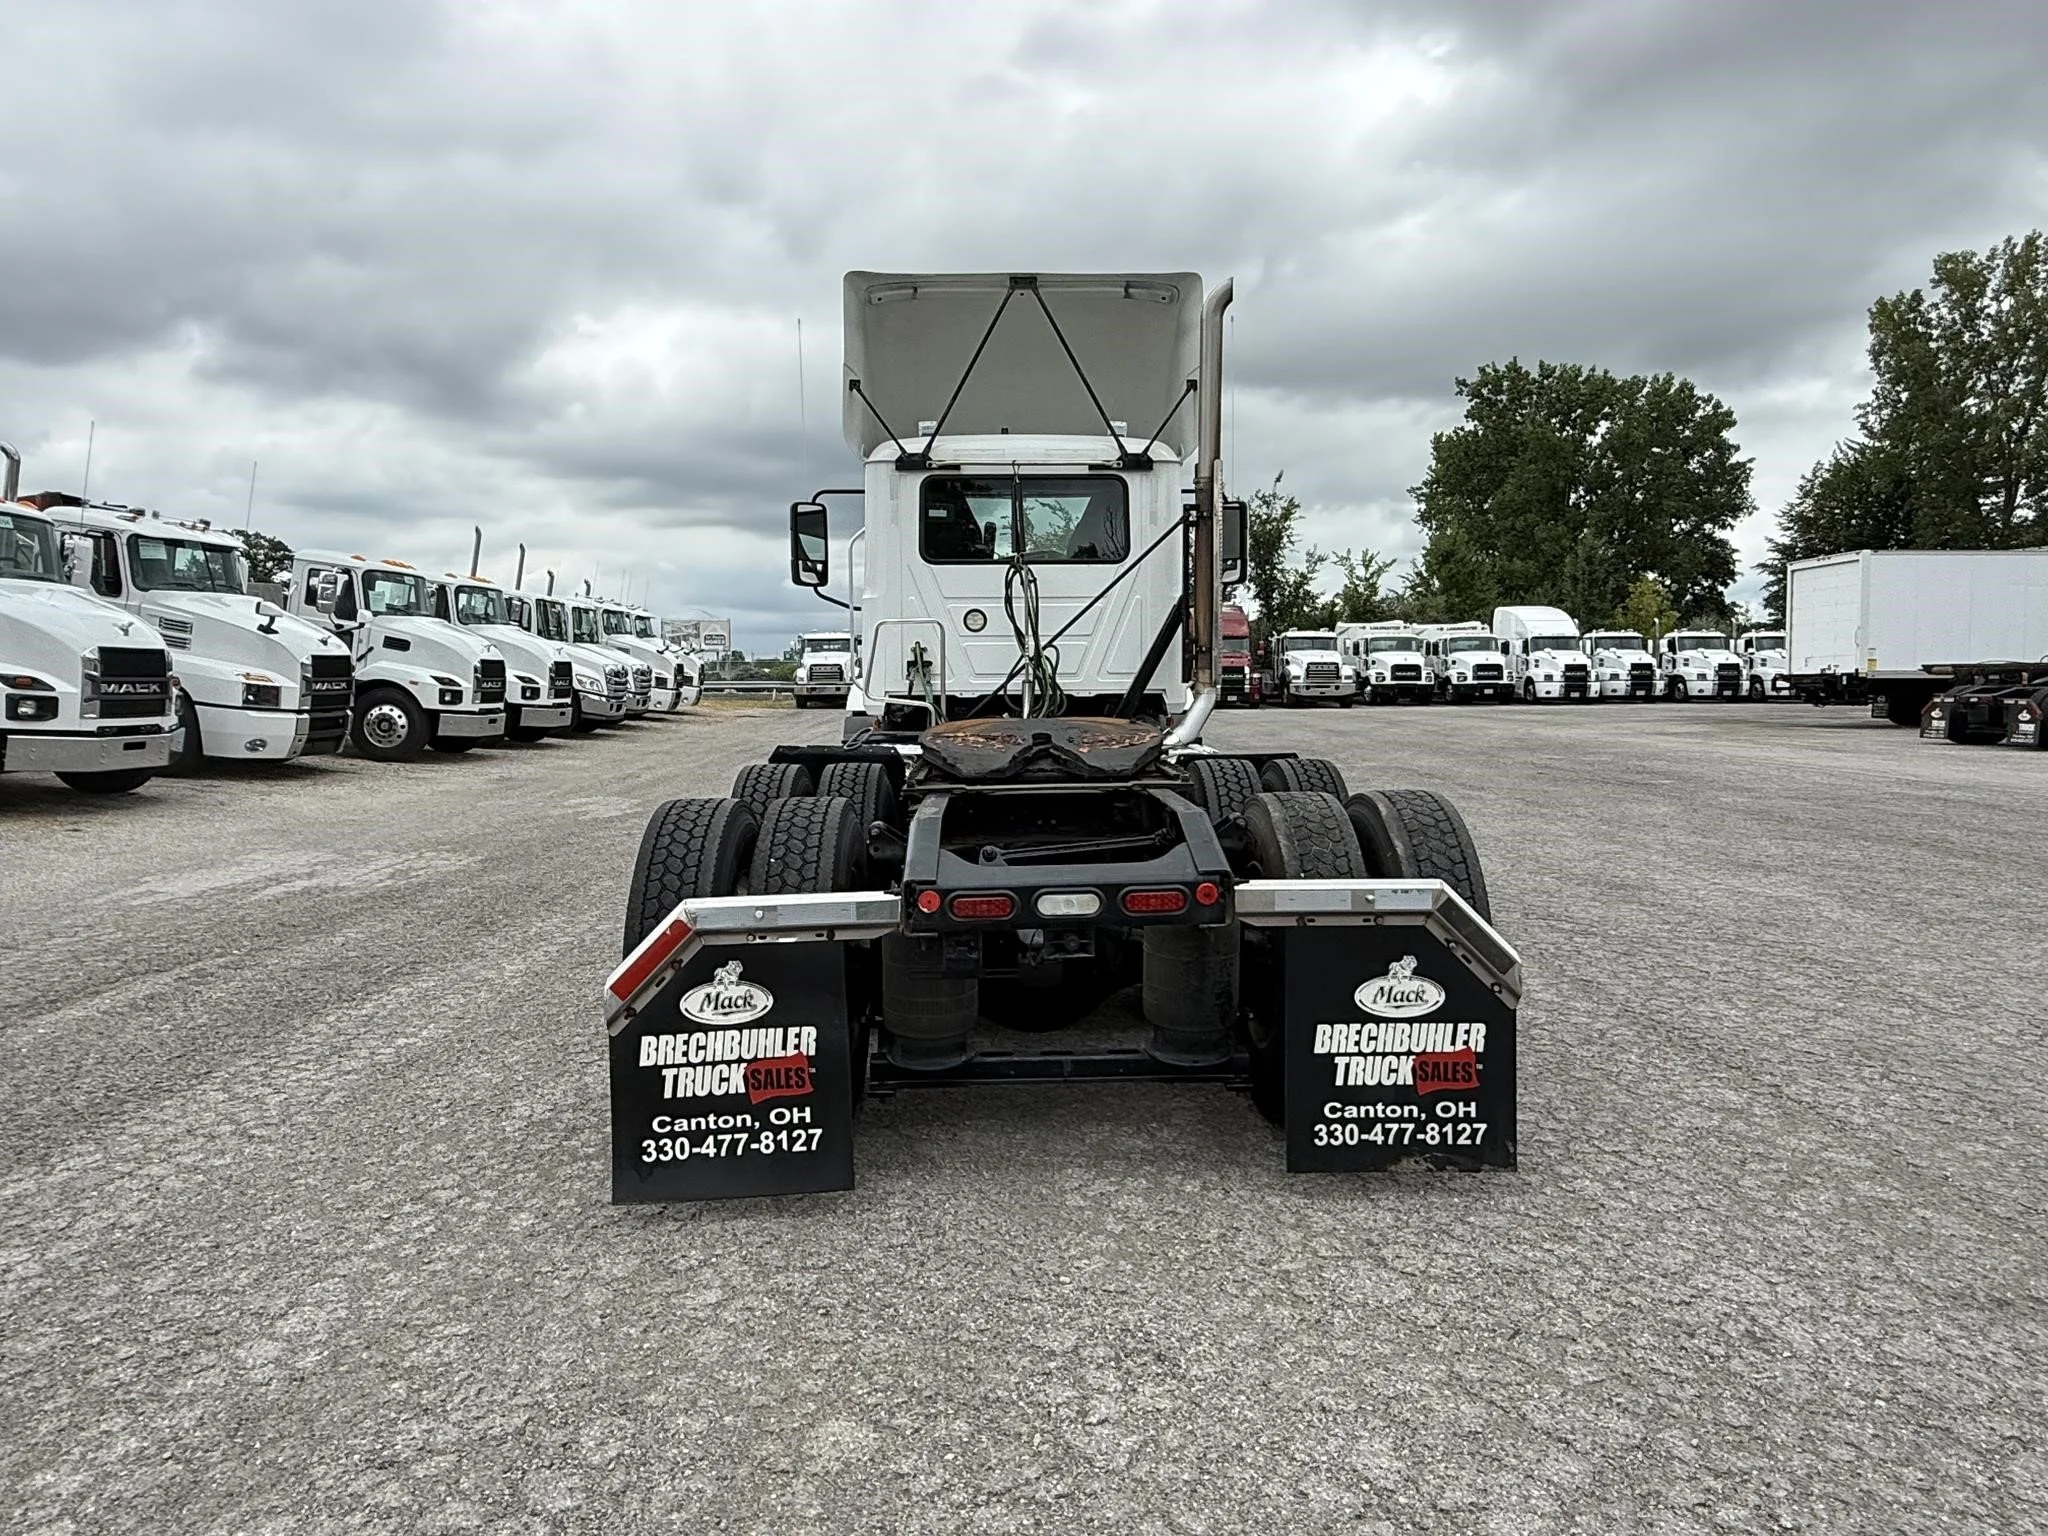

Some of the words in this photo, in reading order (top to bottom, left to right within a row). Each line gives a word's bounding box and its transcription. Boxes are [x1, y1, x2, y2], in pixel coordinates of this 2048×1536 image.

[100, 683, 161, 695] MACK
[312, 681, 348, 690] MACK
[697, 989, 757, 1015] Mack
[1371, 983, 1429, 1008] Mack
[639, 1026, 817, 1067] BRECHBUHLER
[1313, 1022, 1487, 1054] BRECHBUHLER
[662, 1063, 748, 1099] TRUCK
[750, 1067, 806, 1091] SALES
[1334, 1055, 1416, 1086] TRUCK
[1418, 1061, 1473, 1083] SALES
[652, 1112, 760, 1134] Canton,
[769, 1106, 812, 1125] OH
[1323, 1102, 1427, 1120] Canton,
[1435, 1101, 1477, 1118] OH
[641, 1128, 823, 1163] 330-477-8127
[1313, 1122, 1488, 1146] 330-477-8127
